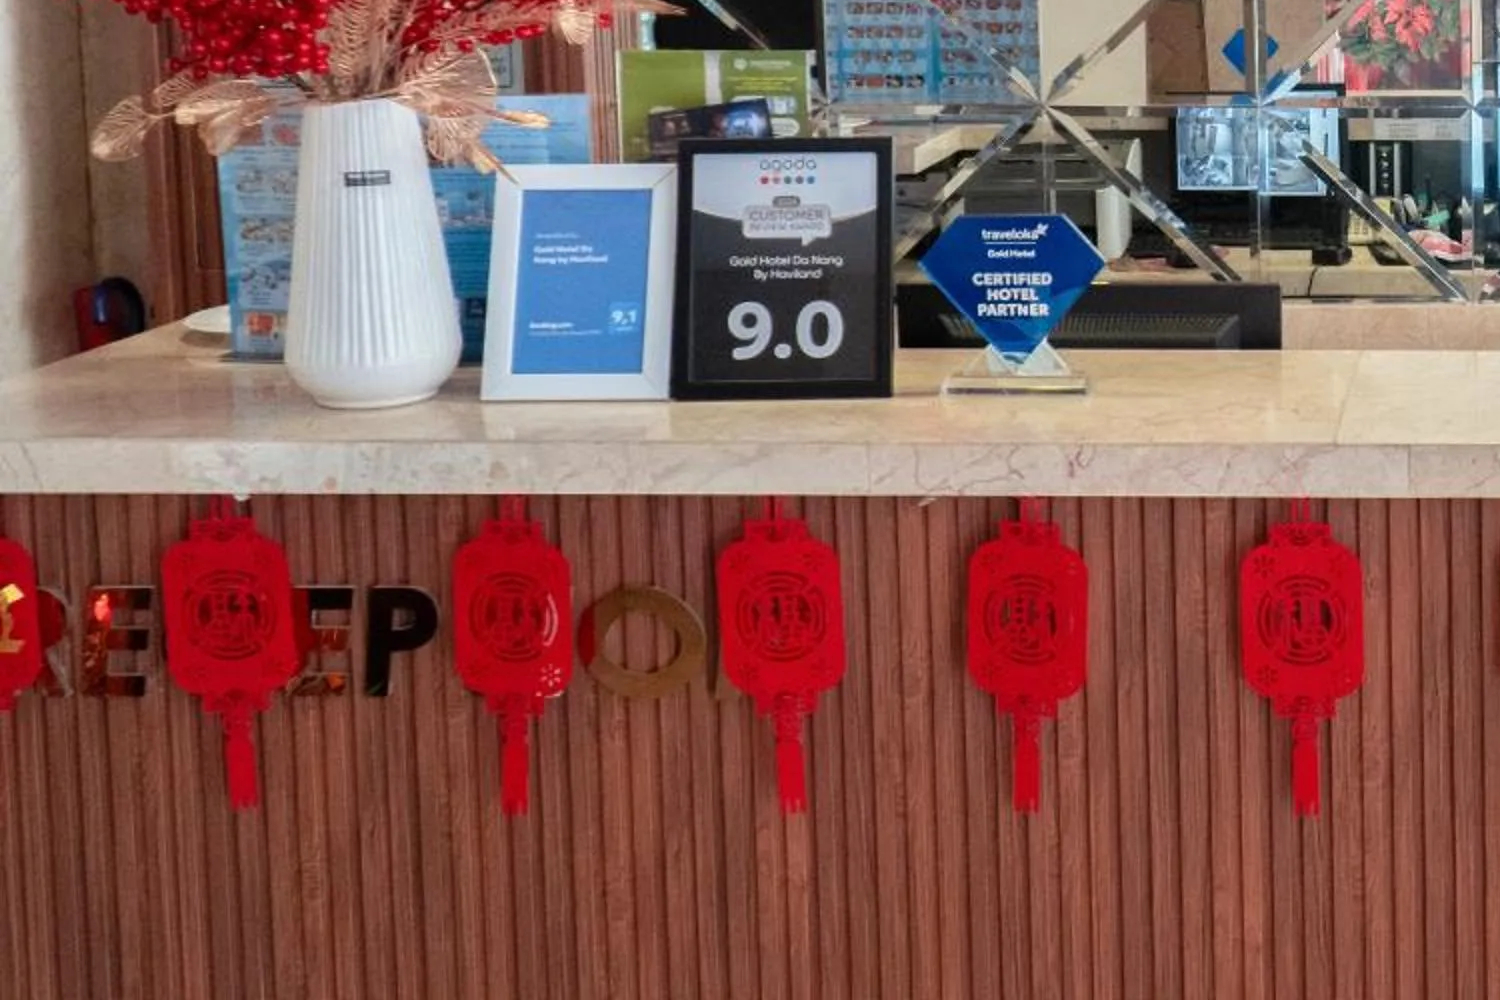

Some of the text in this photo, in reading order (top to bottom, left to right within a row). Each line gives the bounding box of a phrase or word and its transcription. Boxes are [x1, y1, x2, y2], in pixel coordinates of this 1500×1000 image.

[759, 156, 817, 172] agoda
[749, 208, 824, 222] CUSTOMER
[981, 226, 1040, 241] traveloka
[987, 249, 1036, 258] Gold Hotel
[729, 255, 843, 268] Gold Hotel Da Nang
[754, 268, 822, 281] By Haviland
[972, 272, 1053, 286] CERTIFIED
[987, 287, 1039, 301] HOTEL
[977, 303, 1050, 317] PARTNER
[728, 300, 844, 360] 9.0
